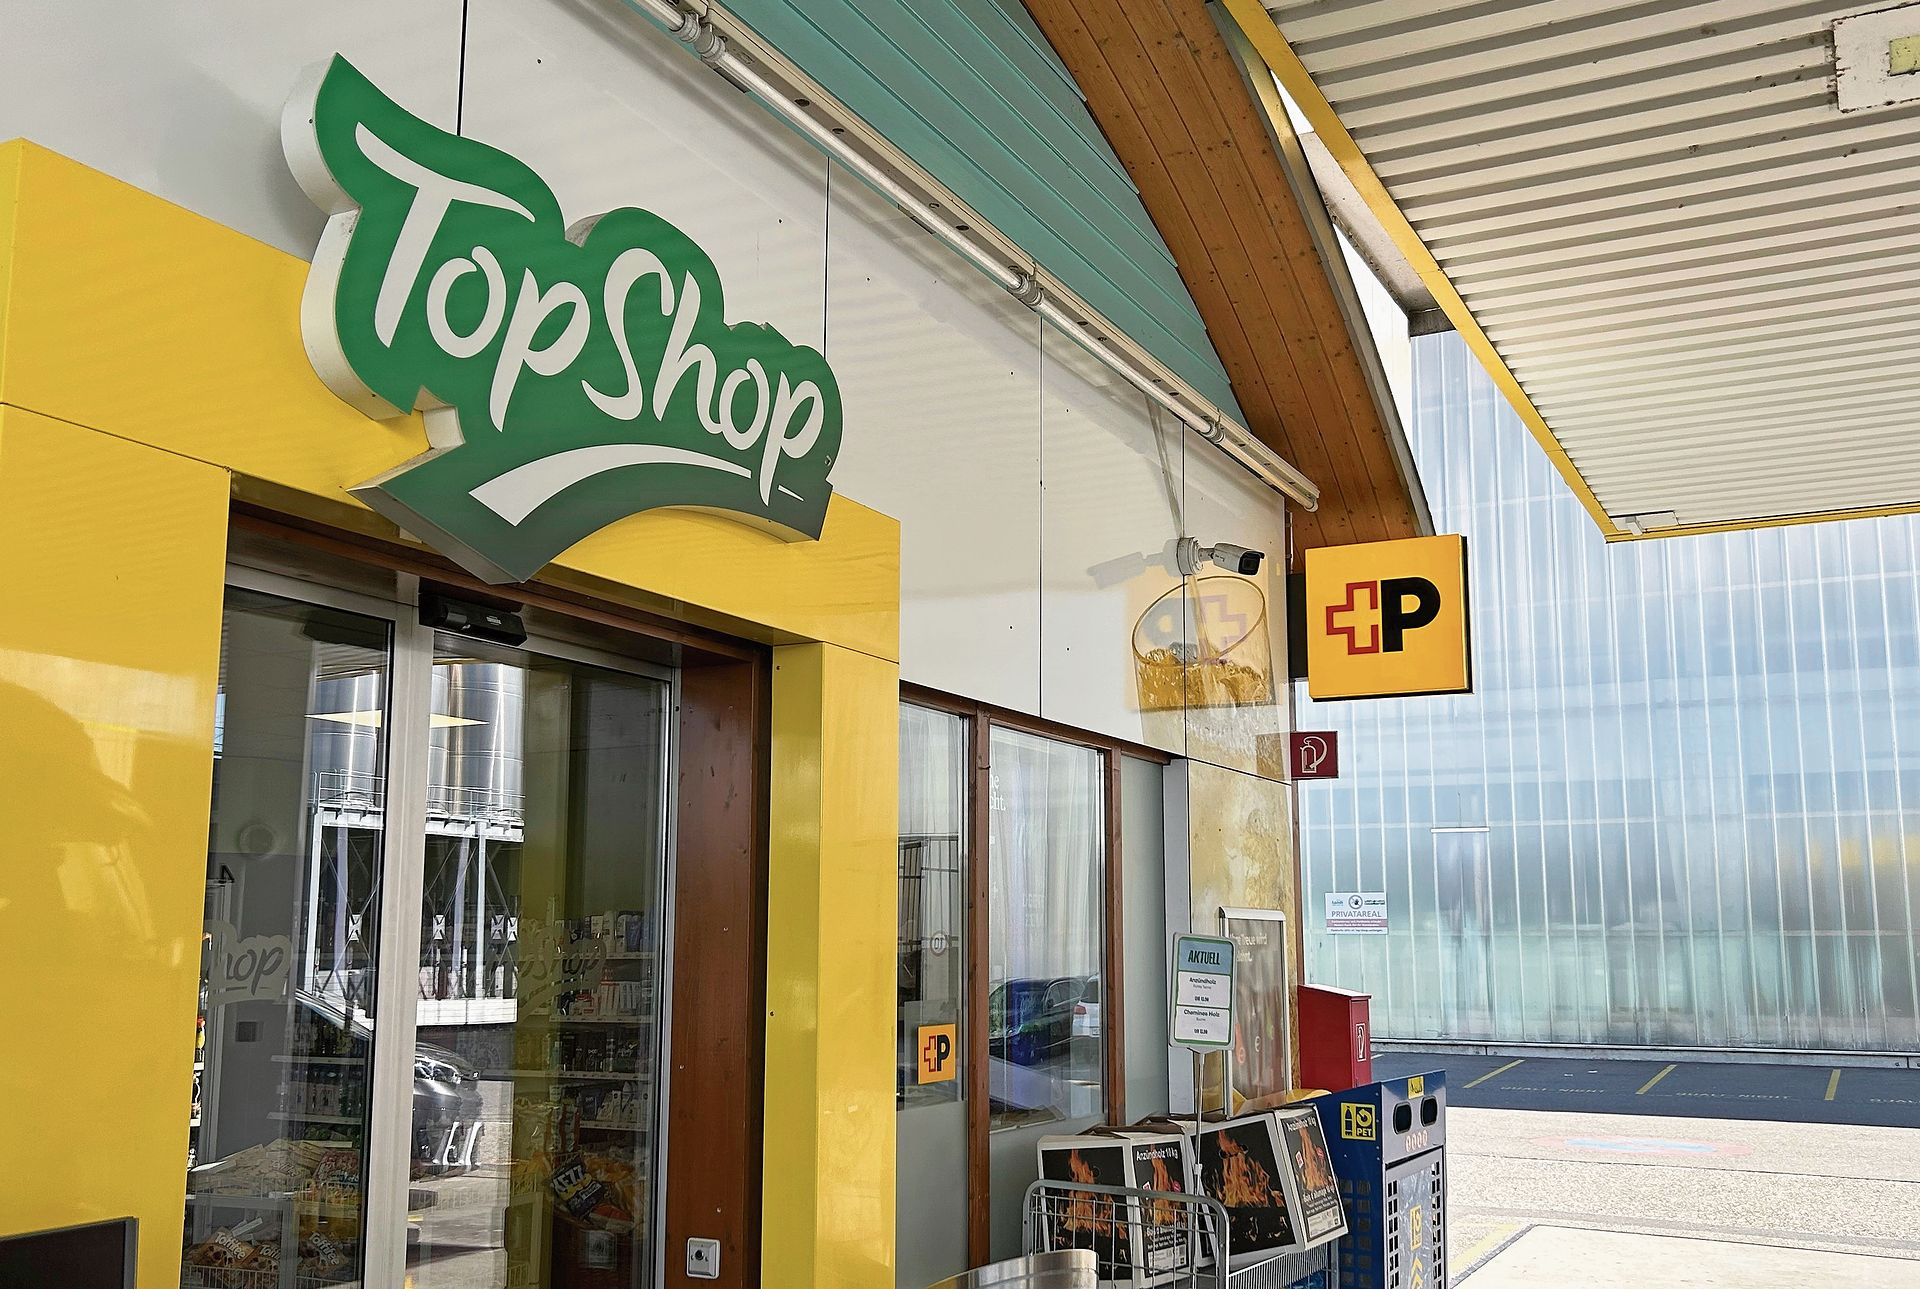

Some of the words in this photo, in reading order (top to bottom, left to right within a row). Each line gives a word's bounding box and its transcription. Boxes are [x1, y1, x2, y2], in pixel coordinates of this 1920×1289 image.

[357, 121, 824, 507] TopShop
[1188, 950, 1221, 966] AKTUELL
[1356, 1128, 1372, 1137] PET
[214, 1231, 246, 1260] Toffifee
